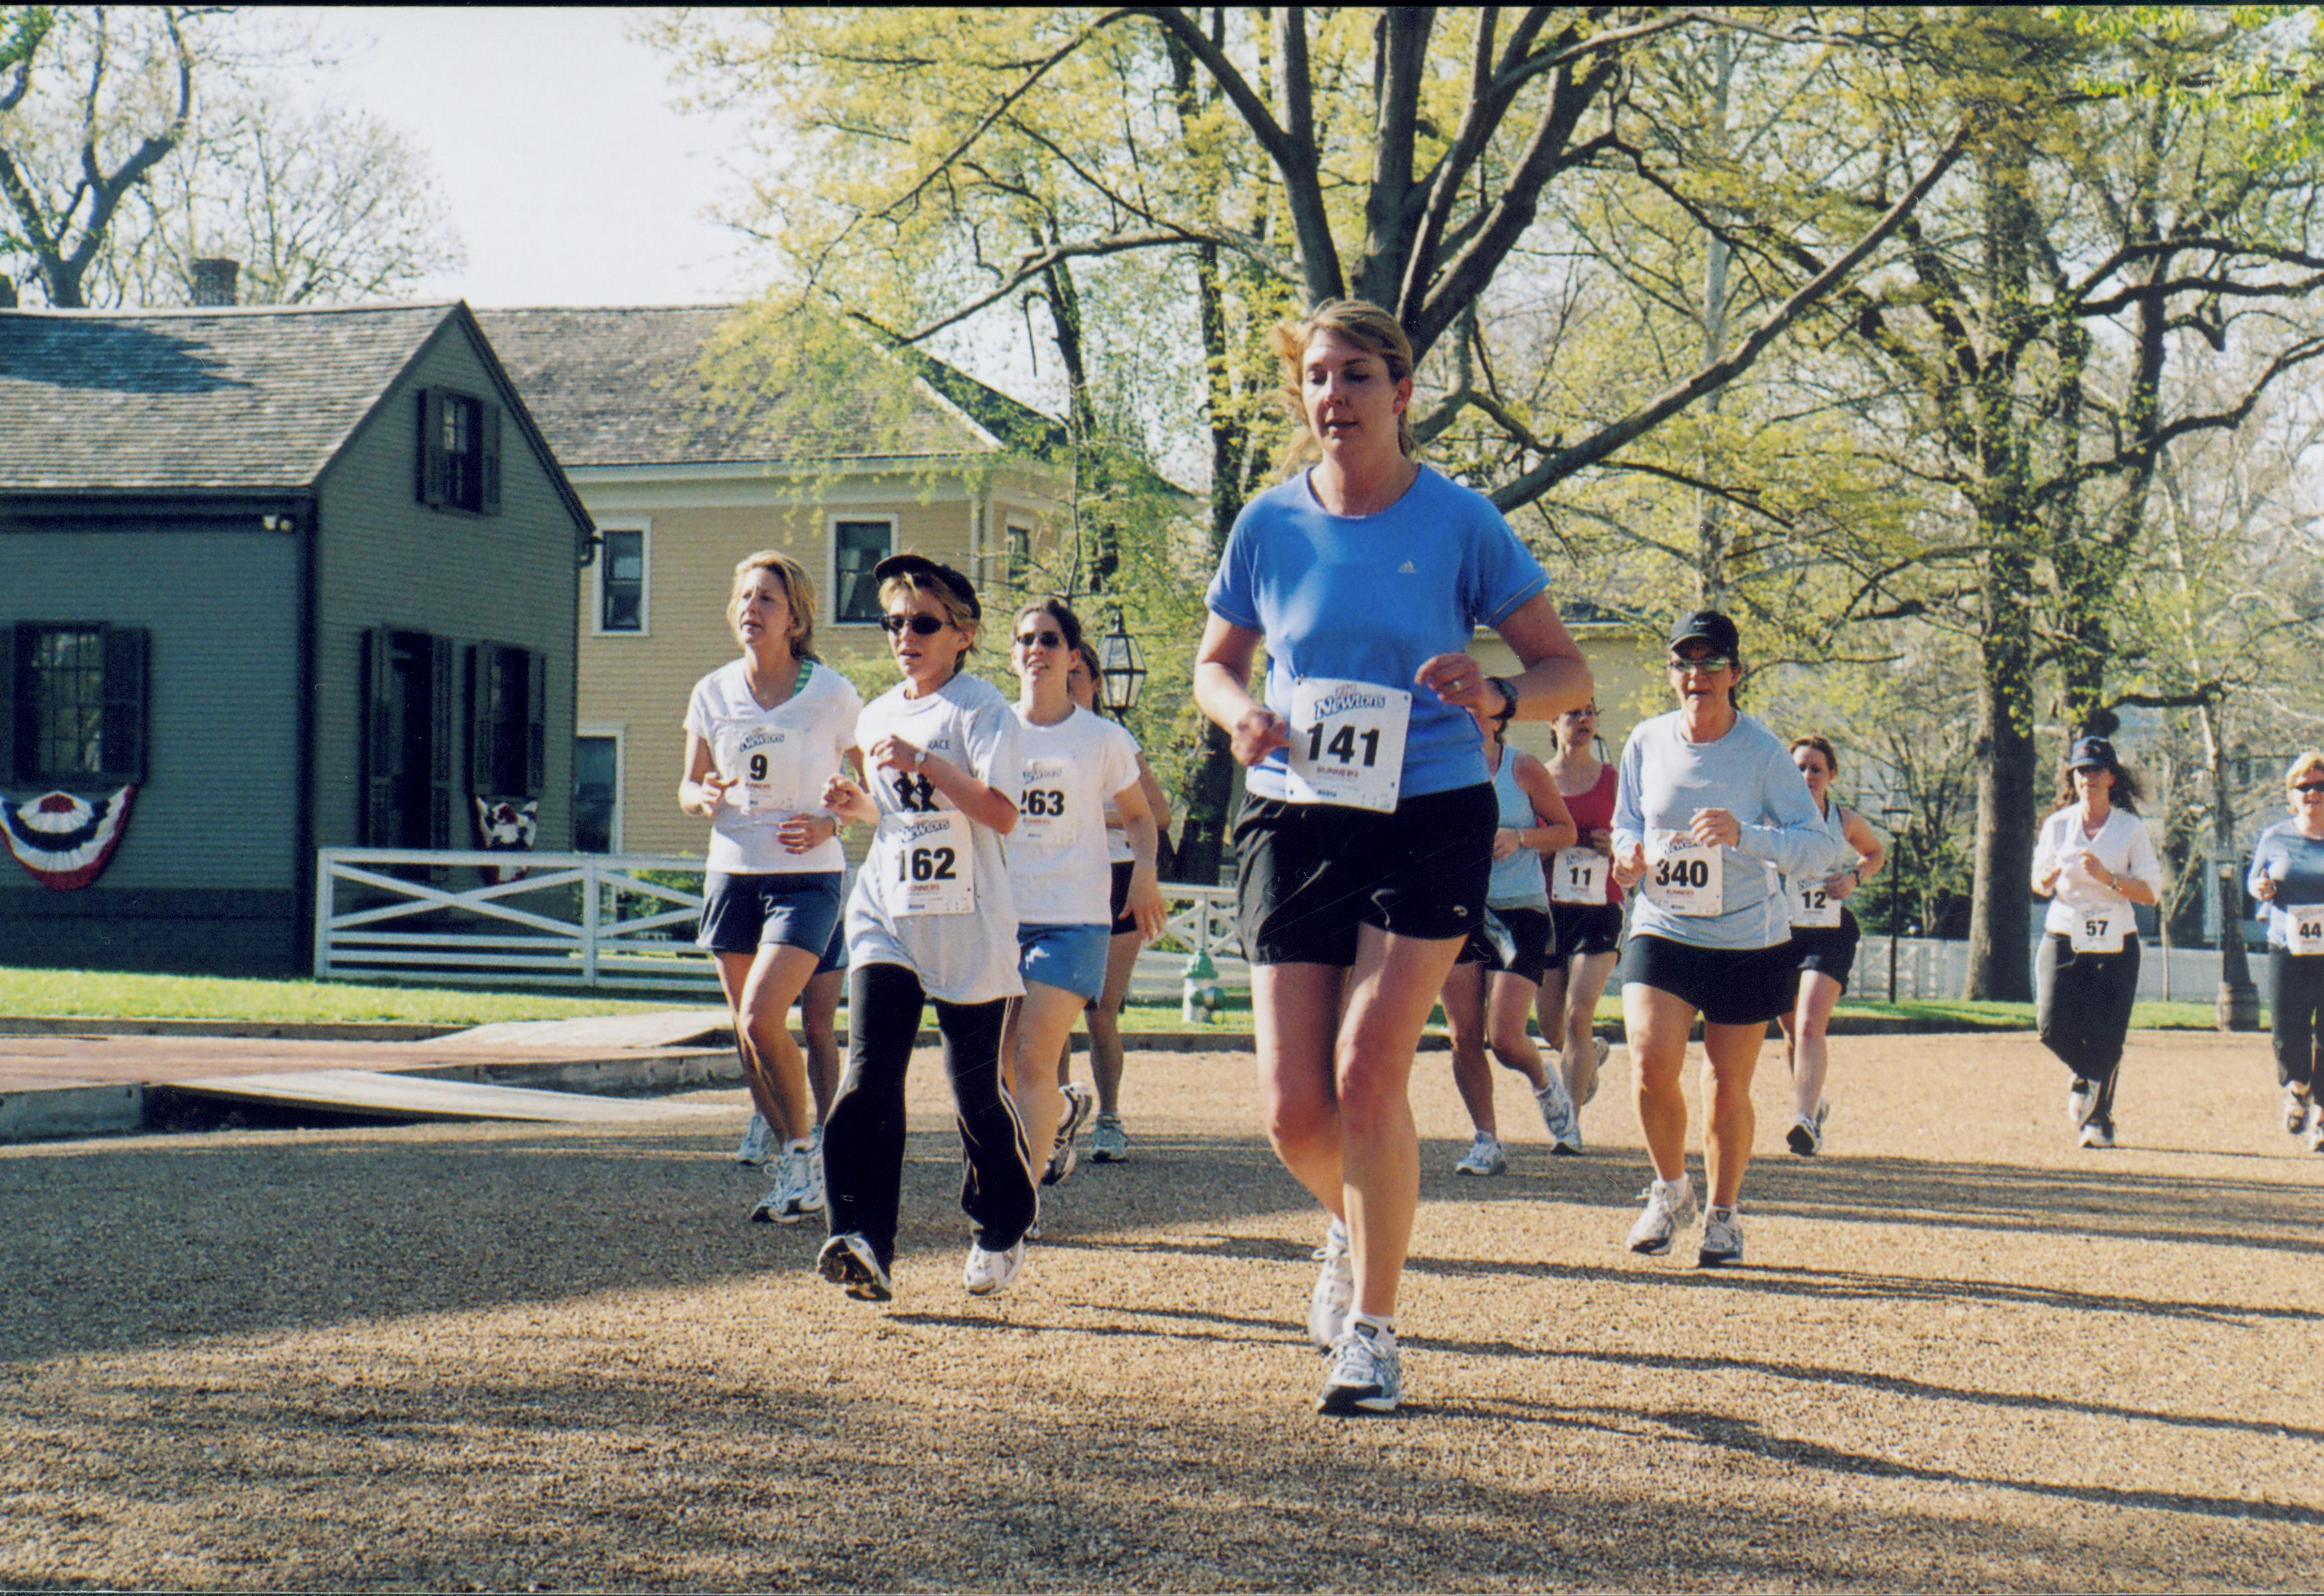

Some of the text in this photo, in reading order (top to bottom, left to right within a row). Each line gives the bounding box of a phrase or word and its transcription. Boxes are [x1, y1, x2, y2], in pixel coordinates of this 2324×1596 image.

[1307, 722, 1379, 767] 141
[750, 753, 767, 781] 9
[895, 848, 956, 882] 162
[1569, 866, 1591, 886] 11
[1655, 858, 1708, 887] 340
[1801, 891, 1826, 909] 12
[2085, 920, 2109, 937] 57
[2299, 922, 2322, 938] 44
